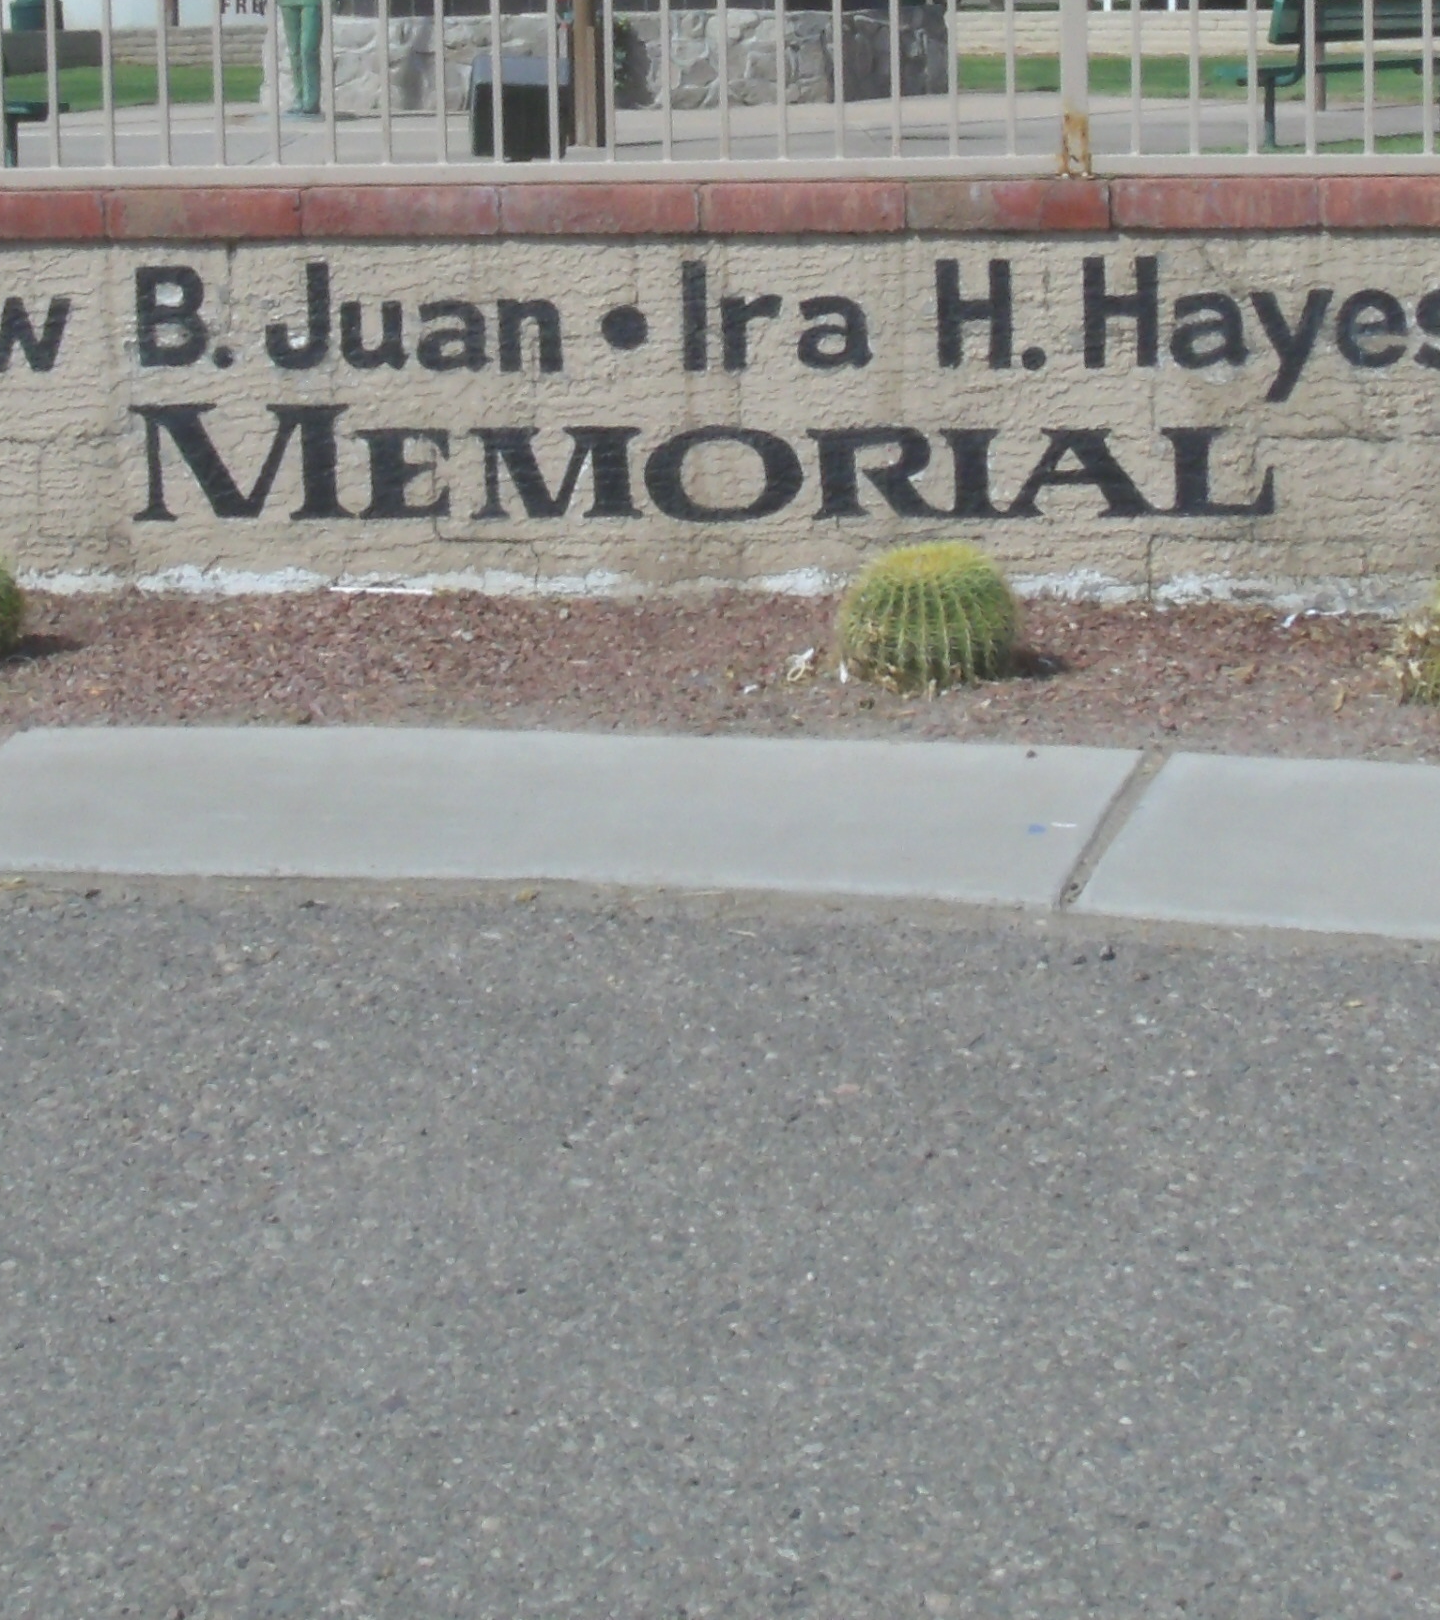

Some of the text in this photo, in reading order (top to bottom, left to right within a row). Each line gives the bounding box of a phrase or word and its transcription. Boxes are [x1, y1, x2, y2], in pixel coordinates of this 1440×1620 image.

[134, 265, 236, 369] B.
[264, 261, 563, 373] Juan
[680, 259, 873, 372] Ira
[934, 258, 1048, 371] H.
[127, 402, 1277, 522] MEMORIAL
